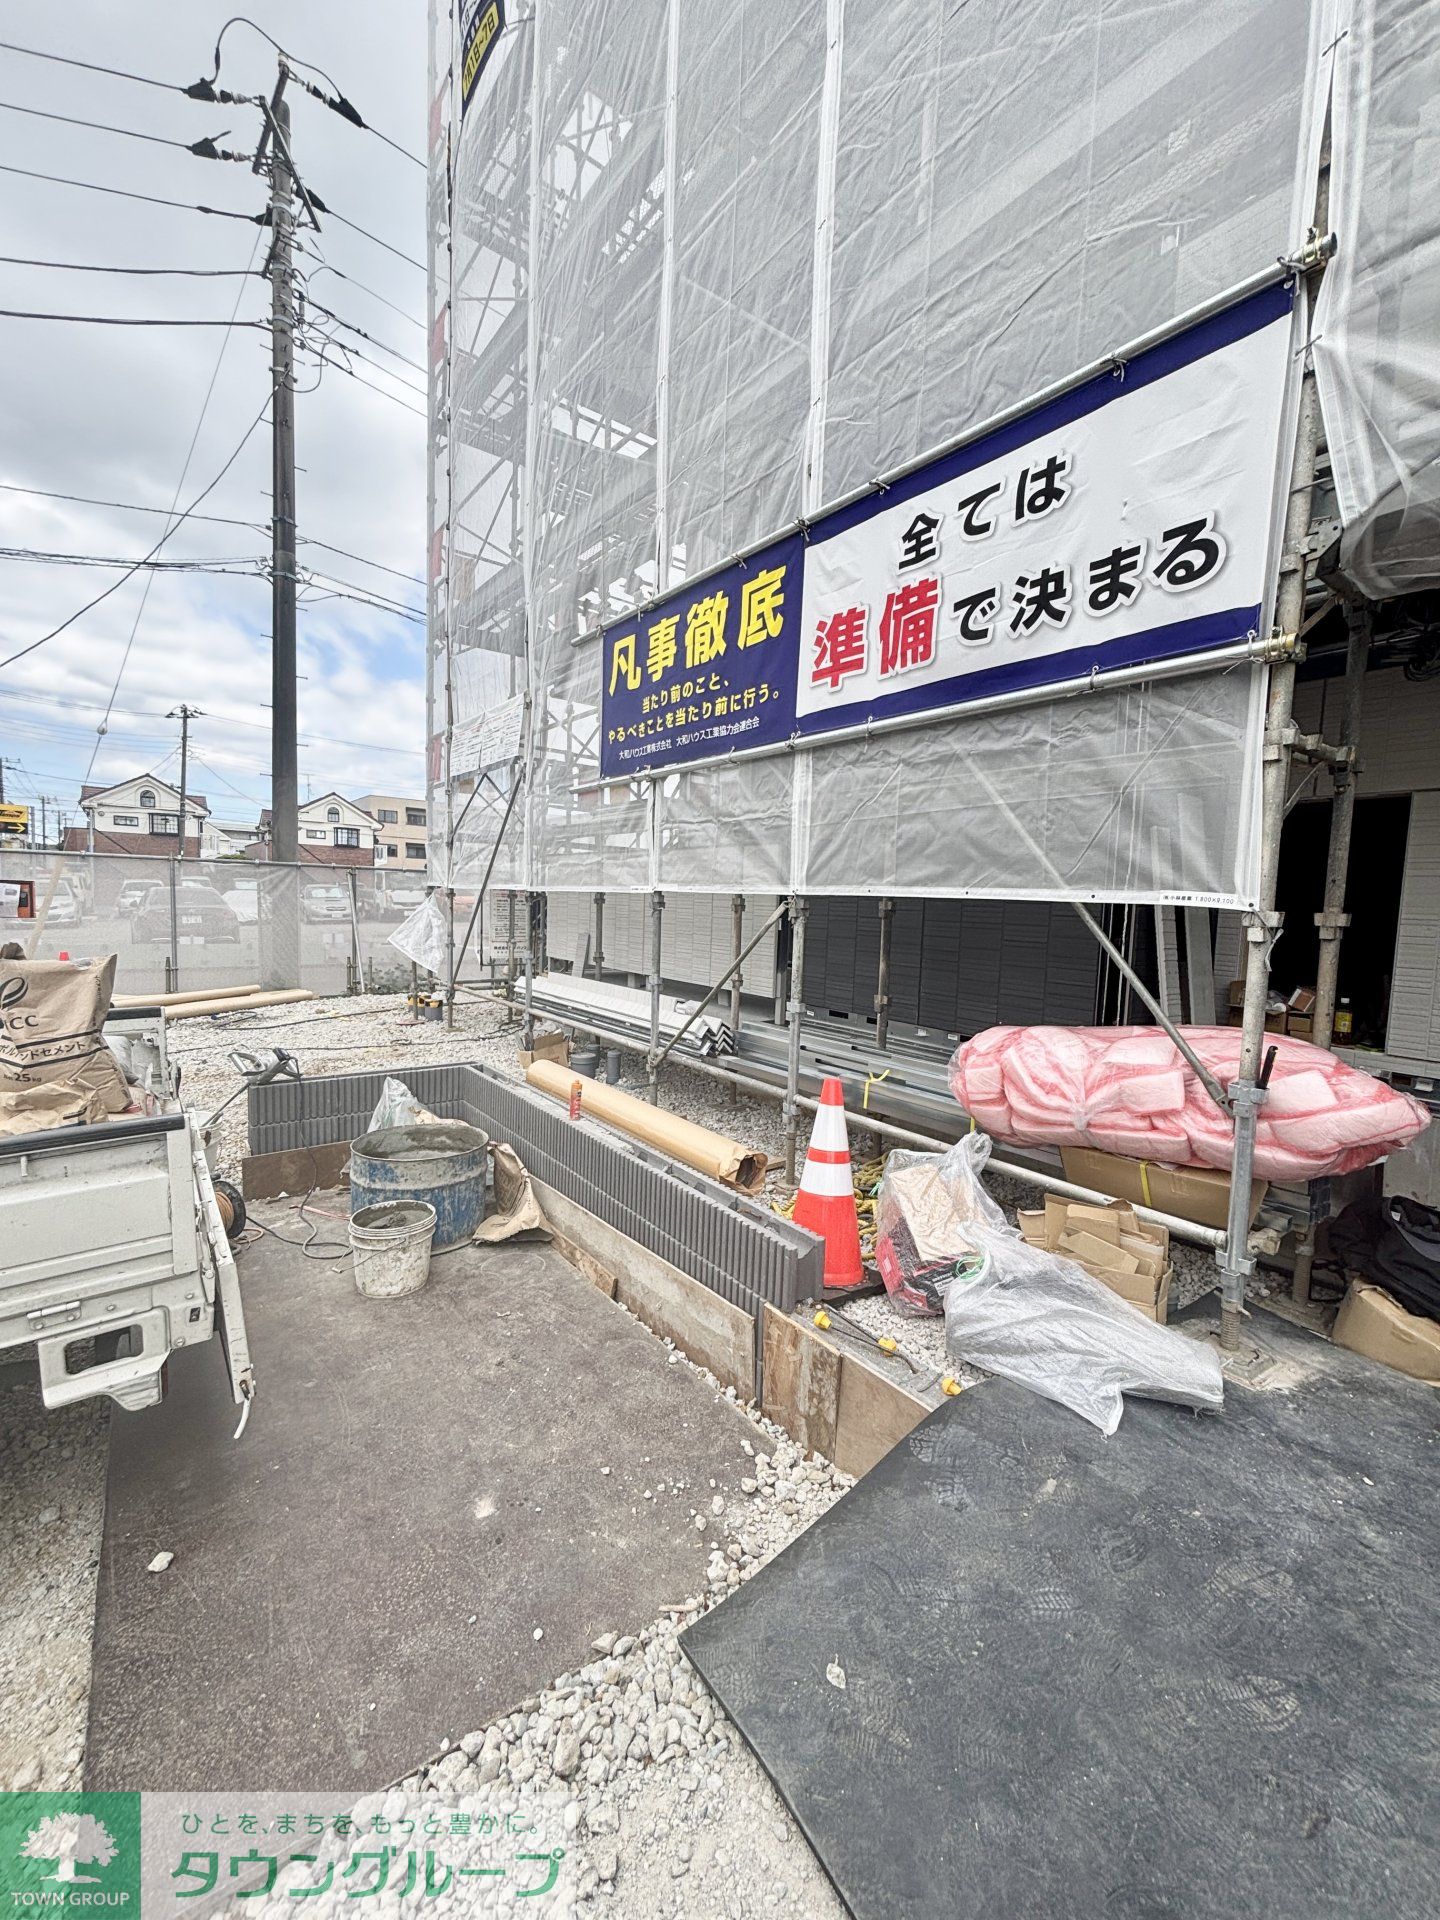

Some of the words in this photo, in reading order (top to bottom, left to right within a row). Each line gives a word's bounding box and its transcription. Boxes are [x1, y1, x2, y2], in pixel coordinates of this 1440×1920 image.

[898, 455, 1068, 570] 全ては
[608, 565, 787, 697] 凡事徹底
[811, 518, 1222, 689] 準備で決まる
[608, 683, 779, 744] やるべきことを当たり前に行う。
[642, 672, 730, 714] 当たり前のこと、
